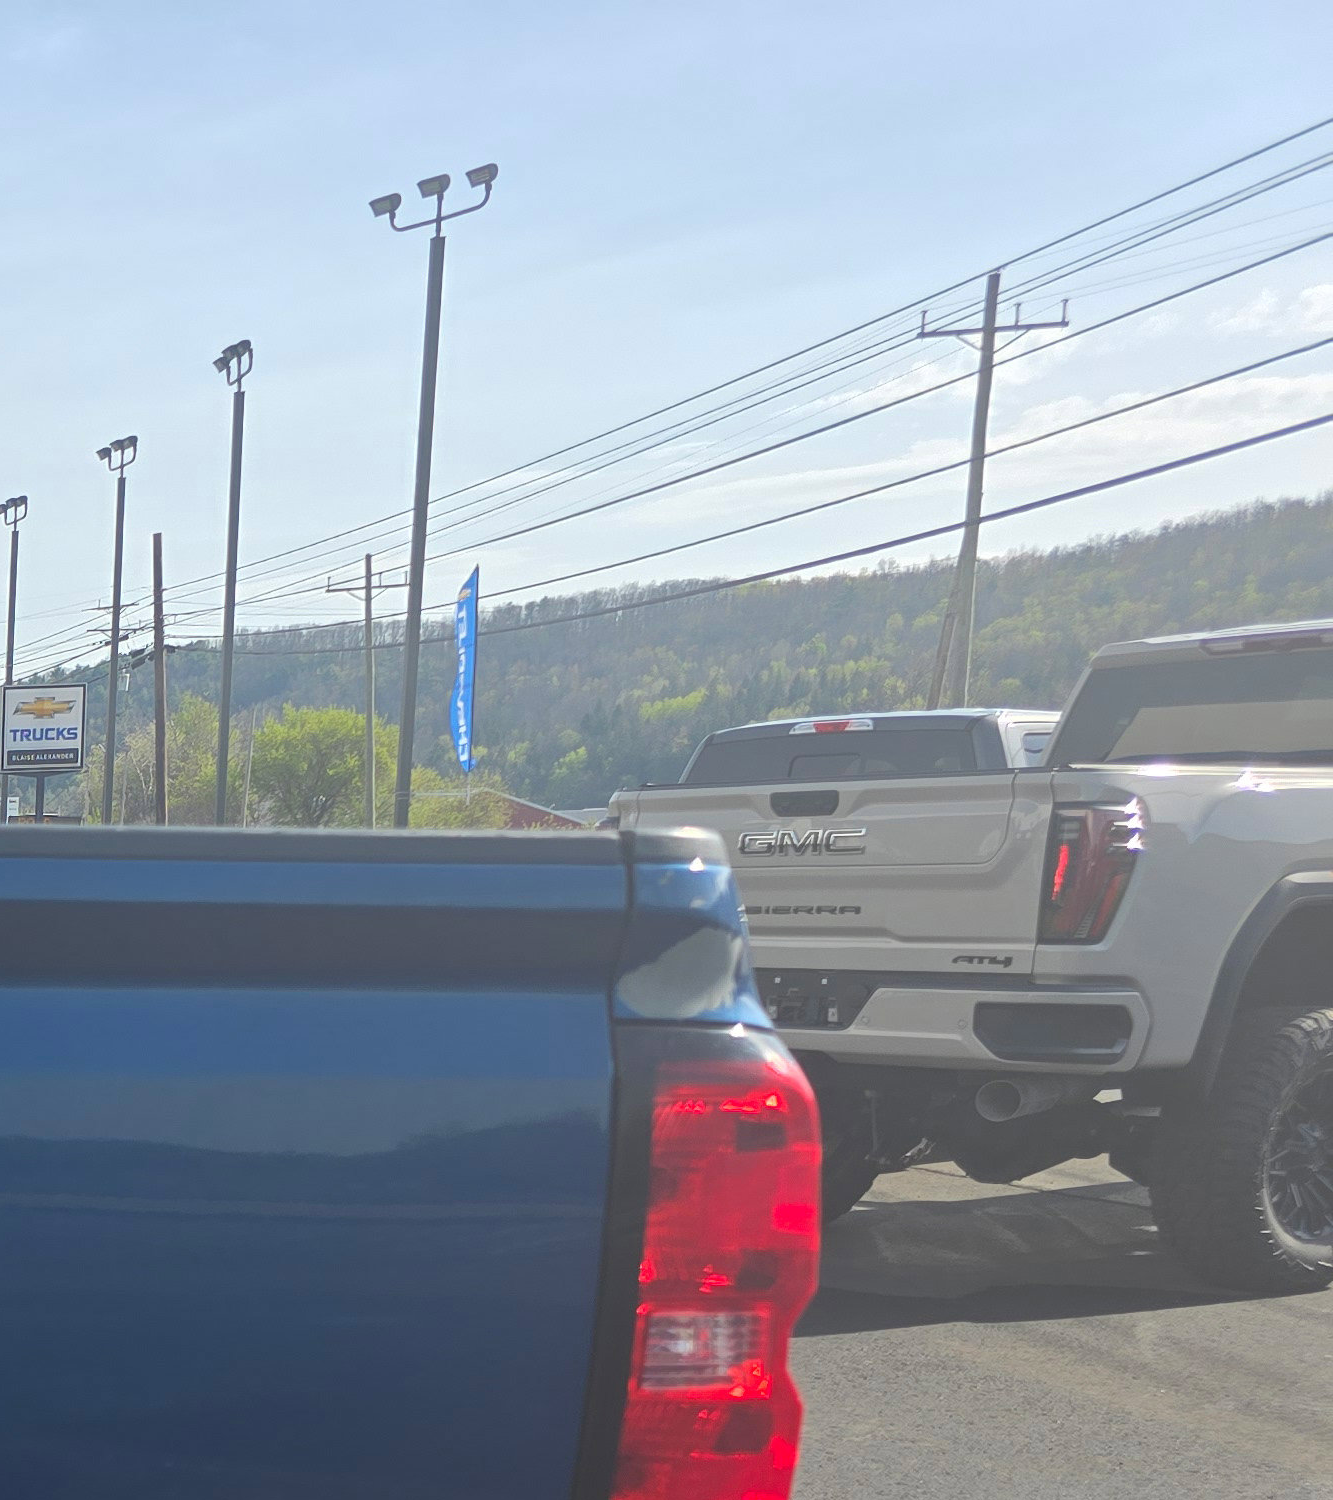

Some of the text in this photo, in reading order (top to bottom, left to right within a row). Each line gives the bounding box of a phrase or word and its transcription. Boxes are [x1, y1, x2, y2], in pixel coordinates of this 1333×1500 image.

[9, 727, 78, 742] TRUCKS
[738, 828, 866, 857] GMC
[743, 905, 861, 915] SIERRA
[951, 955, 1014, 968] AT4
